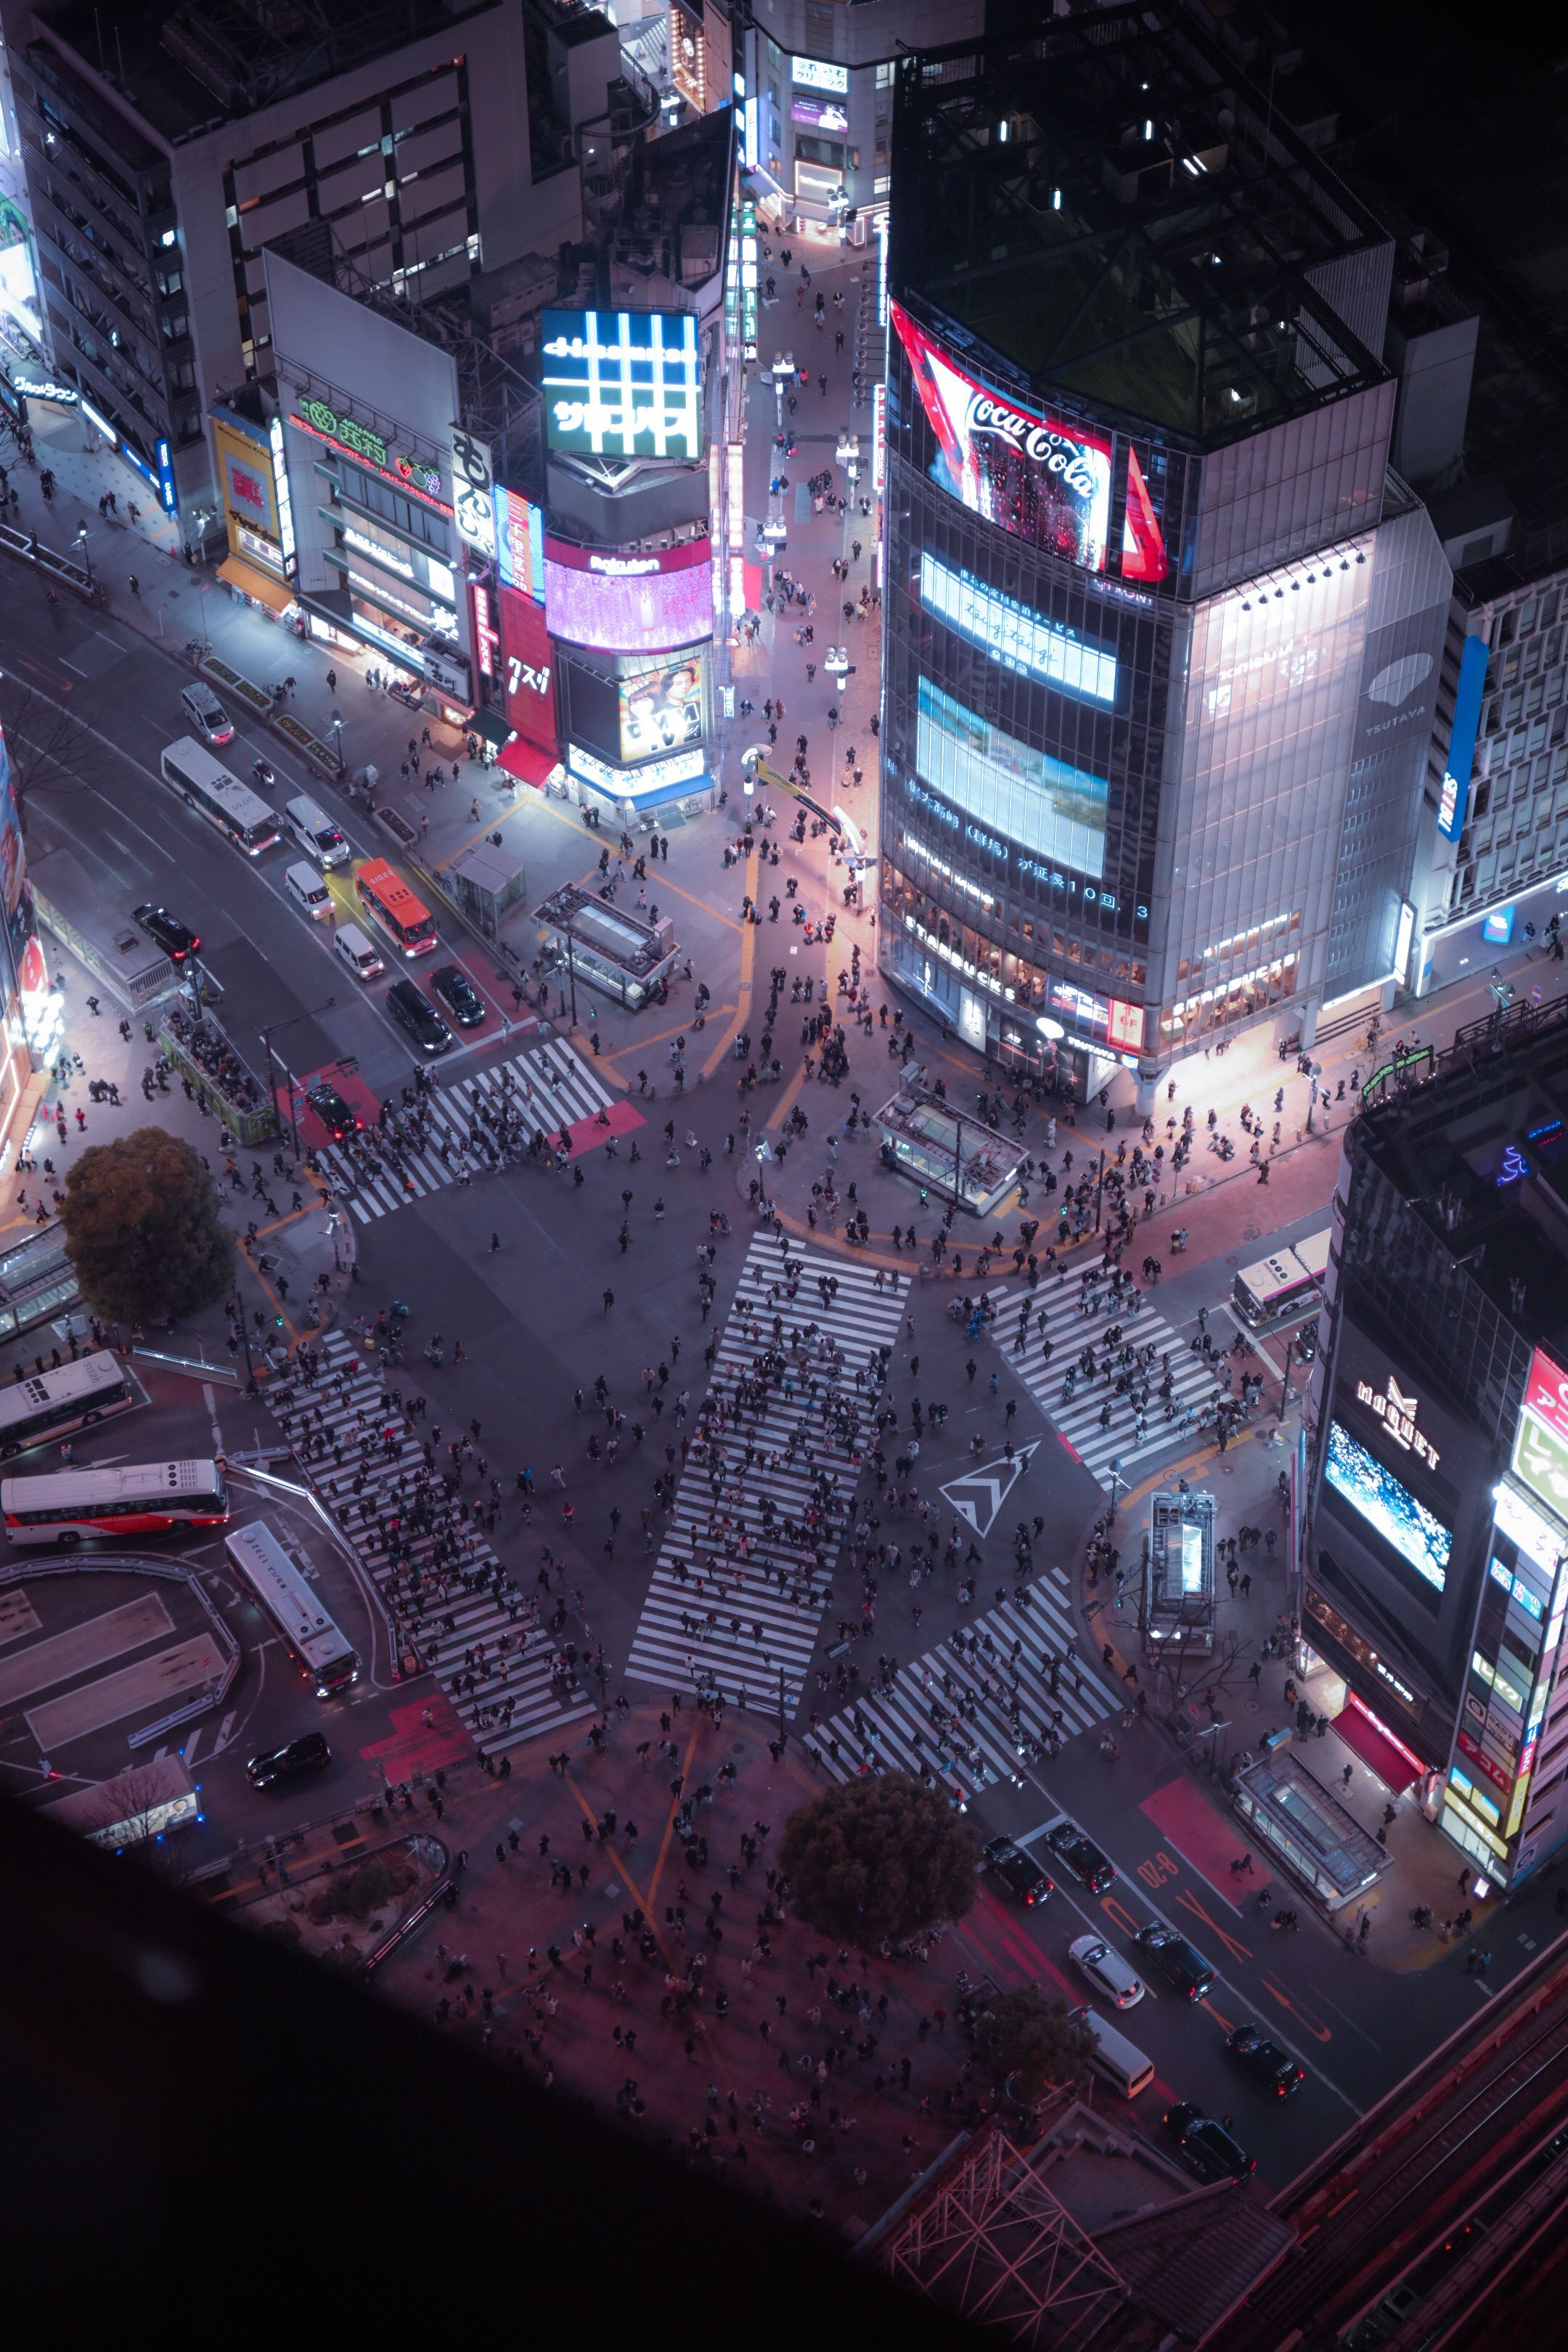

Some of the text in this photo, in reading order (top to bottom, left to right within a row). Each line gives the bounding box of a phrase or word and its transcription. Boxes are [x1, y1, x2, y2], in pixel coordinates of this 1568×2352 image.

[964, 393, 1094, 498] Coca-Cola
[507, 499, 529, 592] 三千里薬品
[589, 555, 661, 576] Rakuten
[1365, 706, 1426, 737] TSUTAYA
[369, 870, 393, 884] 22015
[906, 915, 1015, 1001] STARBUCKS
[1173, 952, 1295, 1016] STARBUCKS
[1068, 1036, 1116, 1061] TSUTAYA
[83, 1361, 100, 1383] 31328
[1357, 1381, 1440, 1470] MAGNET
[1466, 1739, 1505, 1786] アコム
[1138, 1852, 1179, 1889] 8-20
